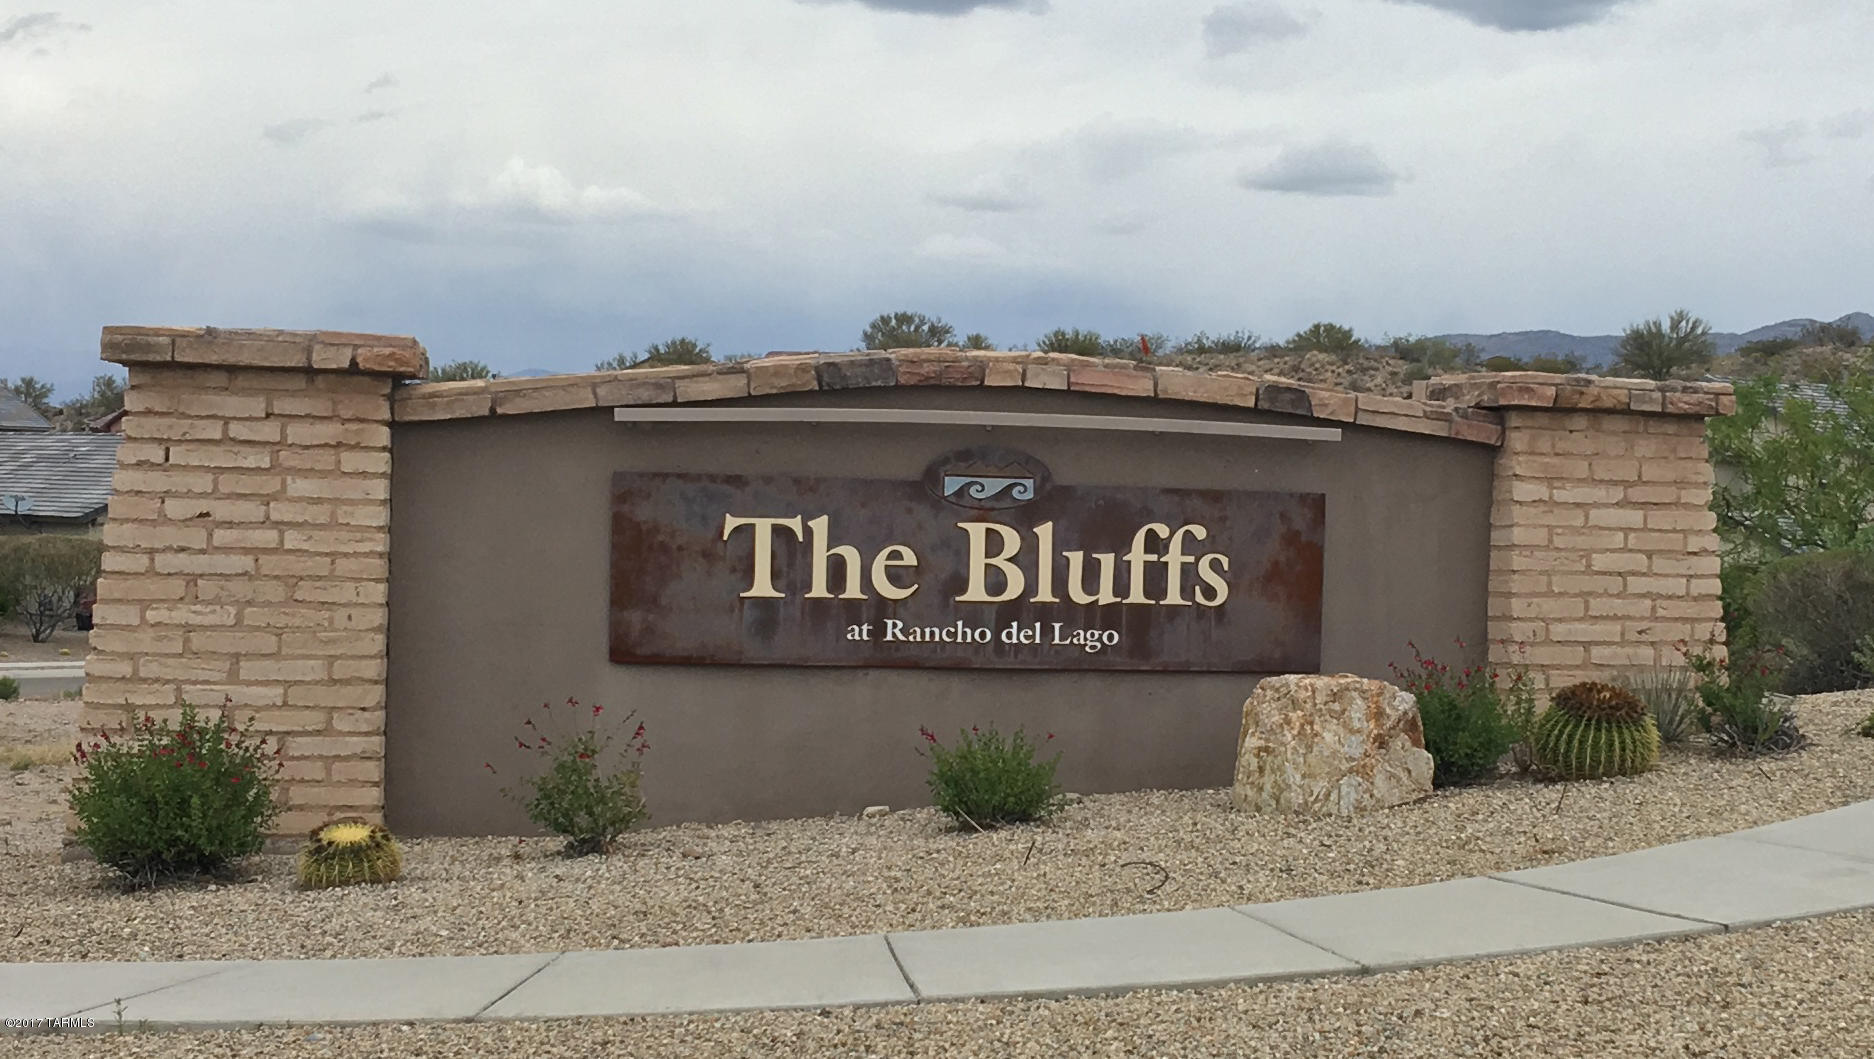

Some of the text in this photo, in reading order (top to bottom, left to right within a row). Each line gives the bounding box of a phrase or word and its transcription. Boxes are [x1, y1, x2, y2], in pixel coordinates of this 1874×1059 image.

[723, 514, 1228, 606] The Bluffs
[847, 619, 1118, 652] at Rancho del Lago
